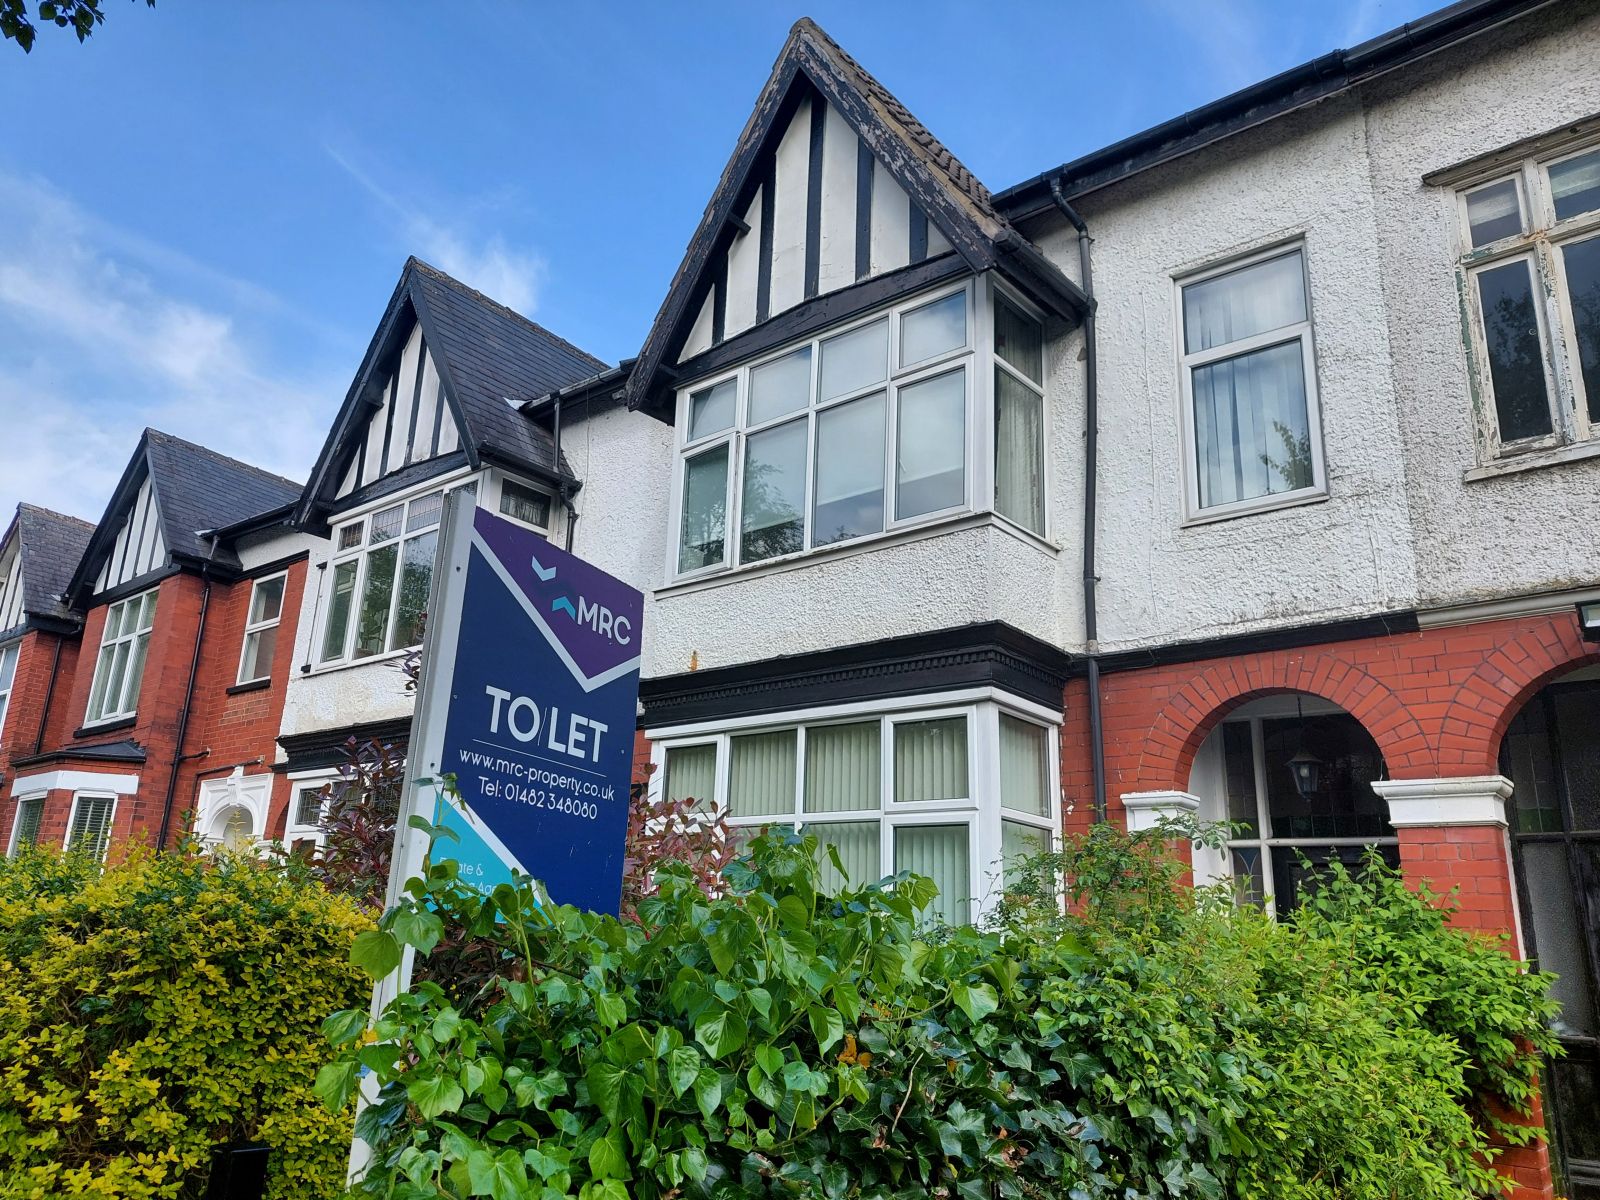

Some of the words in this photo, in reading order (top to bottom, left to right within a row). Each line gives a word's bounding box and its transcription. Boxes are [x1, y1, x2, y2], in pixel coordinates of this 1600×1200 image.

[577, 595, 631, 645] MRC
[485, 685, 541, 742] TO
[548, 706, 608, 762] LET
[459, 749, 615, 801] www.mrc-property.co.uk
[478, 776, 501, 798] Tel:
[505, 783, 544, 808] 01482
[548, 793, 598, 819] 348080
